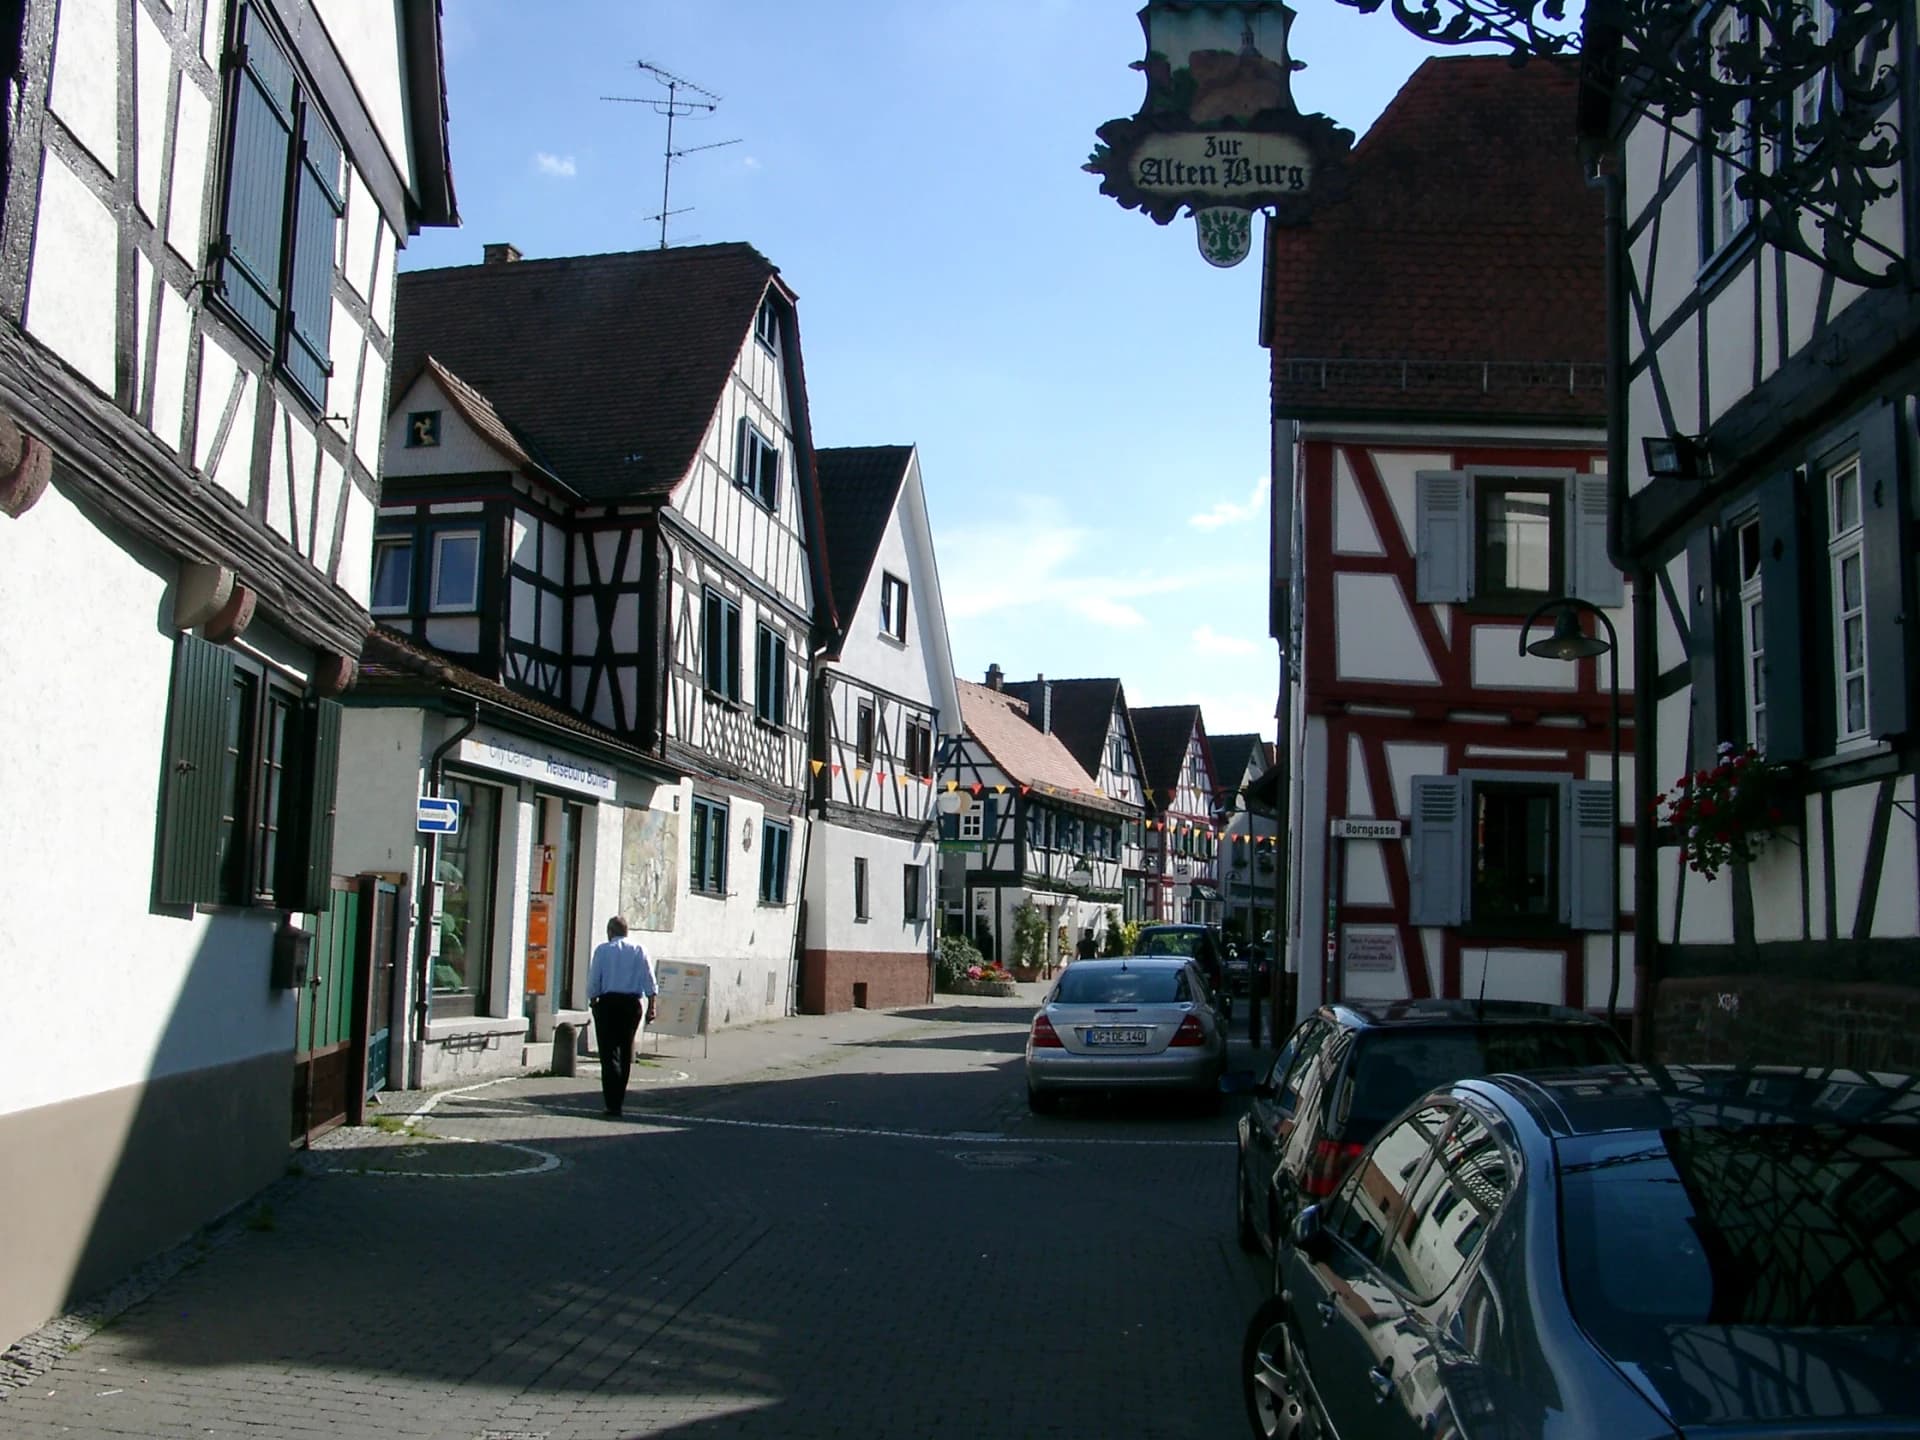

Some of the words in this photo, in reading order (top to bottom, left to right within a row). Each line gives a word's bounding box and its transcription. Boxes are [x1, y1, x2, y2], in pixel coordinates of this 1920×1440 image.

[1203, 135, 1243, 159] Zur
[1138, 157, 1218, 186] Alten
[1223, 157, 1305, 190] Burg
[1346, 822, 1396, 837] Borngasse
